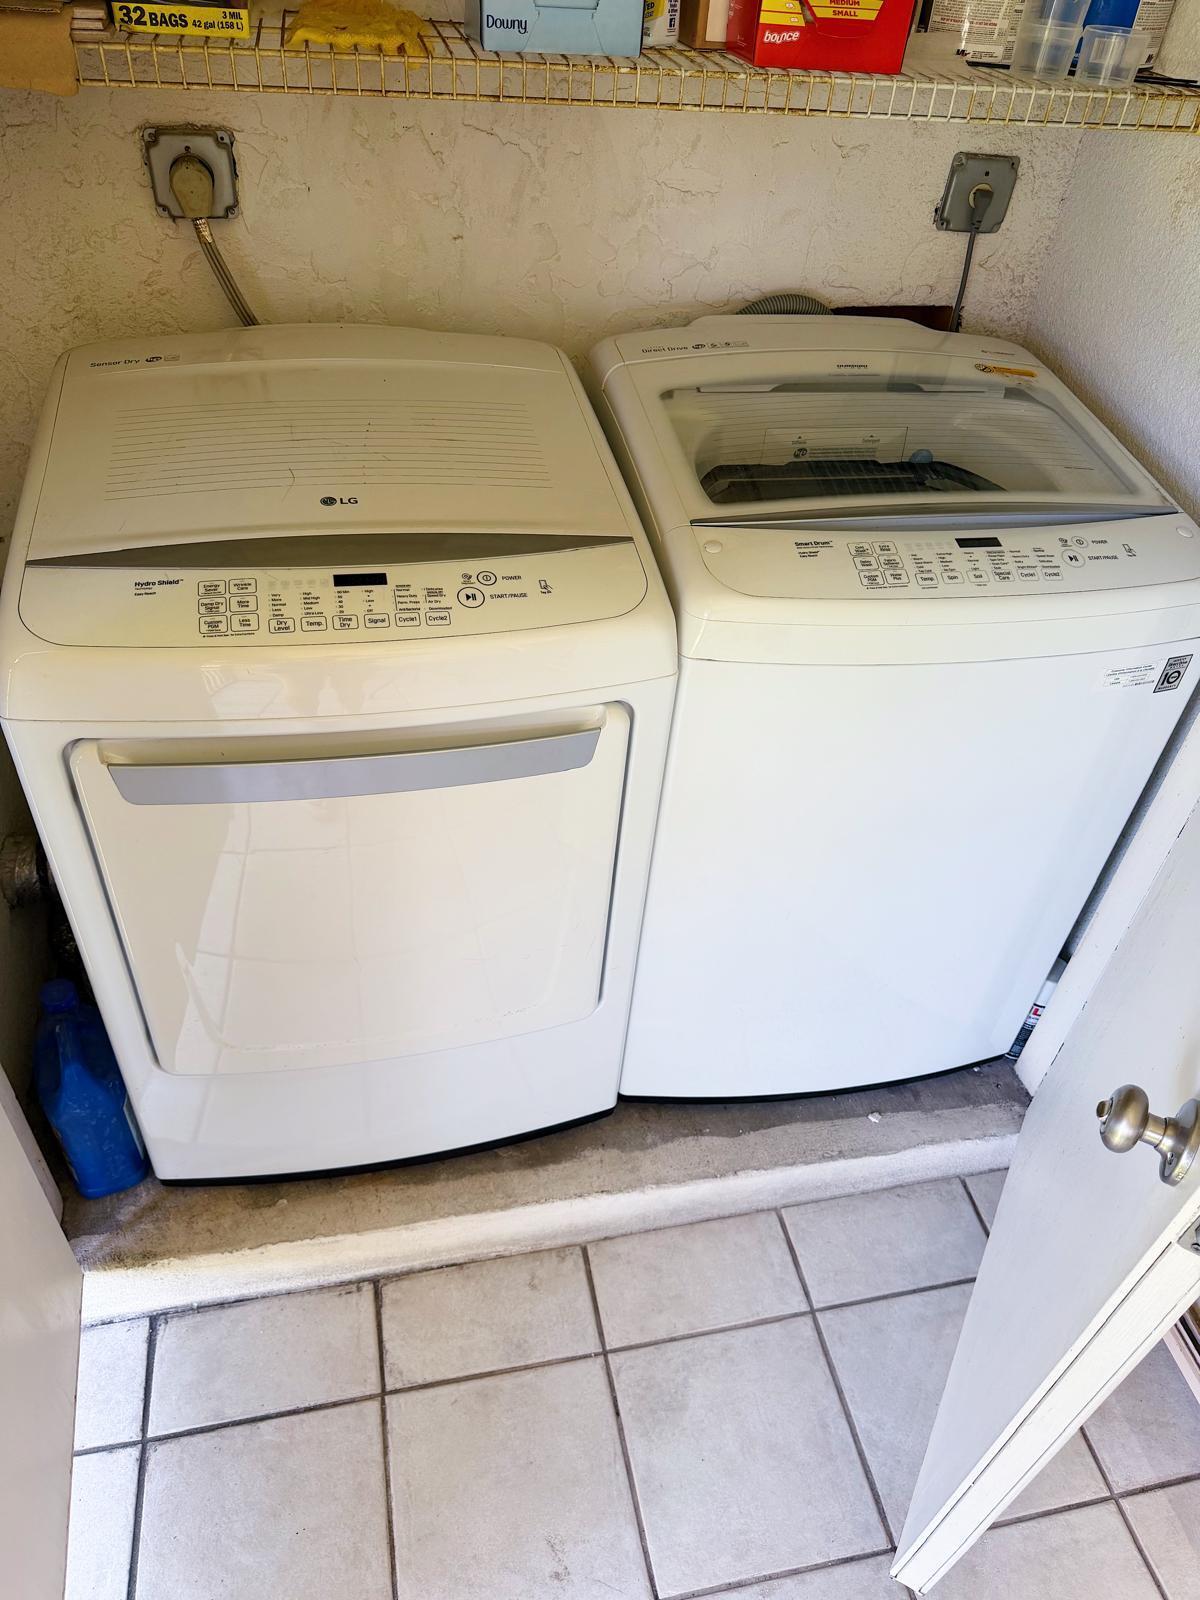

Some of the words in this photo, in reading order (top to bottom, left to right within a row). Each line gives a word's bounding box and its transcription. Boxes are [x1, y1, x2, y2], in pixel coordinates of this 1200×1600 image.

[118, 5, 147, 26] 32
[148, 12, 188, 28] BAGS
[221, 11, 227, 19] 3
[228, 11, 243, 20] MIL
[832, 9, 858, 17] SMALL
[192, 19, 203, 28] 42
[203, 20, 215, 30] gal
[217, 21, 235, 31] (158
[235, 22, 244, 31] L)
[486, 14, 527, 35] Downy
[764, 30, 799, 44] bounce
[89, 360, 122, 368] Sensor
[339, 497, 358, 505] LG
[134, 580, 156, 588] Hydro
[489, 592, 528, 600] START/PAUSE
